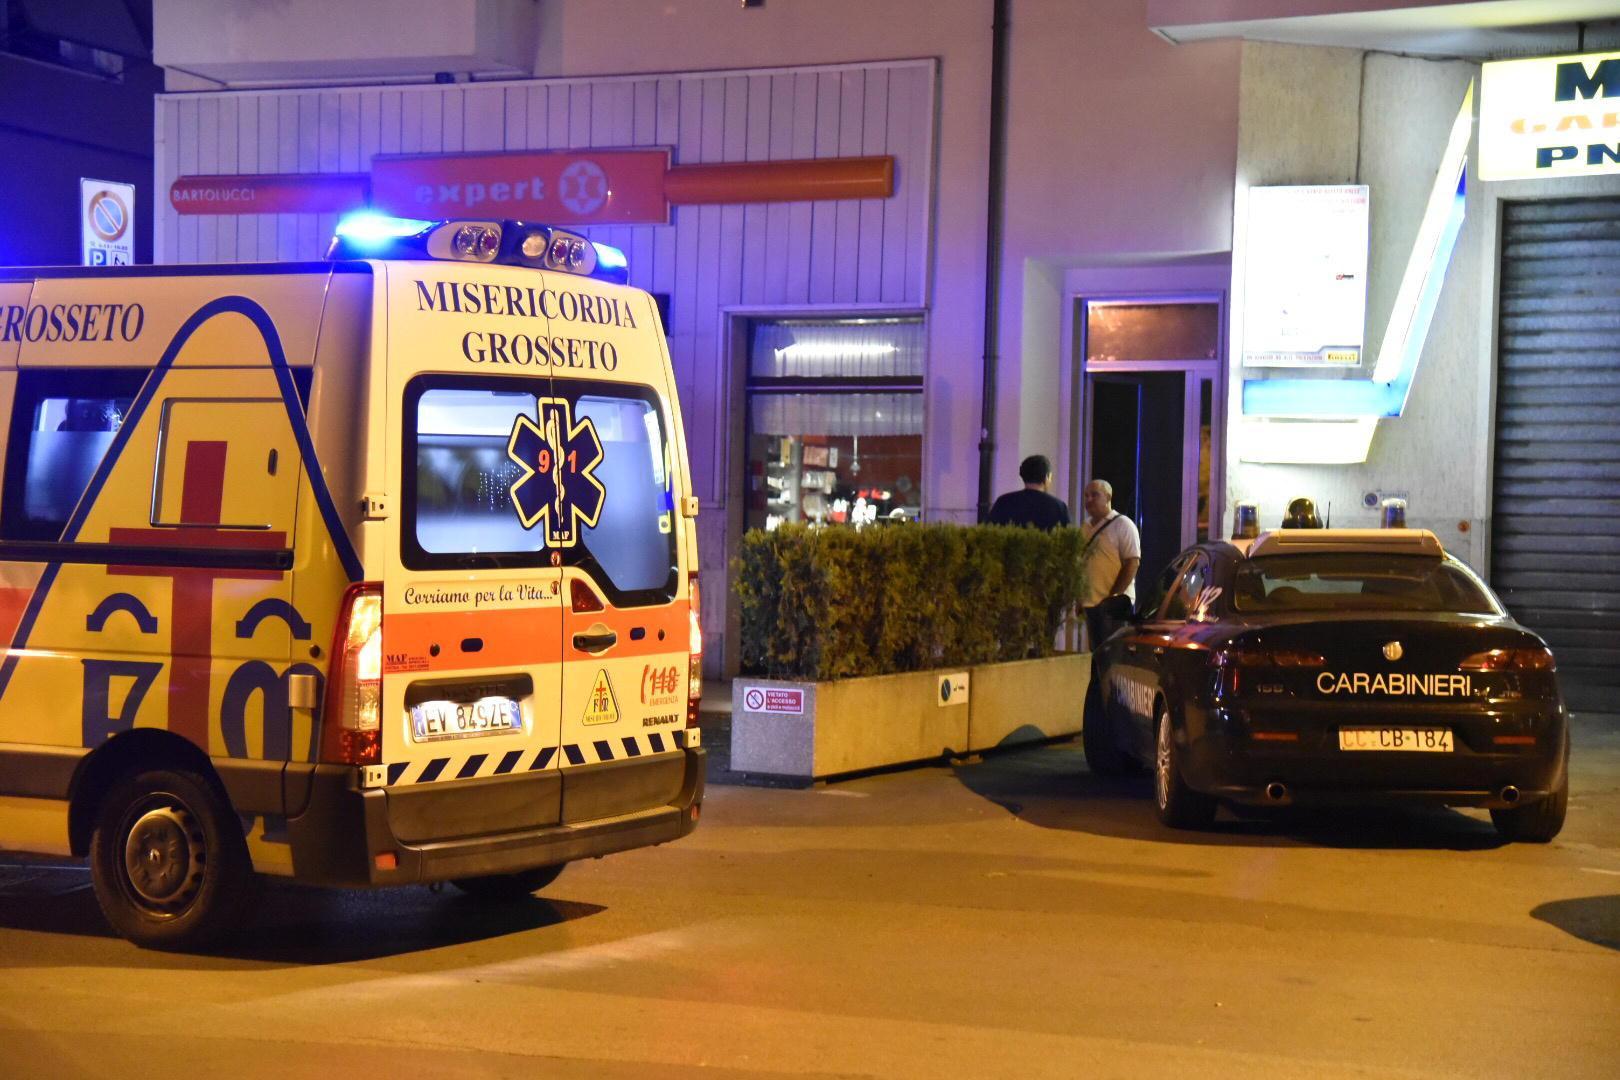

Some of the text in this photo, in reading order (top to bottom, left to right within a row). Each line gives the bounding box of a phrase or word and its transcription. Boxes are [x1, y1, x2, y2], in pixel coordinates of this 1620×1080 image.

[172, 188, 255, 201] BARTOLUCCI
[414, 176, 545, 207] expert
[414, 280, 638, 329] MISERICORDIA
[0, 303, 144, 342] ROSSETO
[462, 331, 618, 371] GROSSETO
[404, 587, 469, 605] Corriamo
[475, 591, 495, 607] per
[499, 585, 513, 601] la
[649, 666, 678, 695] 118
[1316, 671, 1471, 697] CARABINIERI
[642, 715, 679, 726] RENAULT
